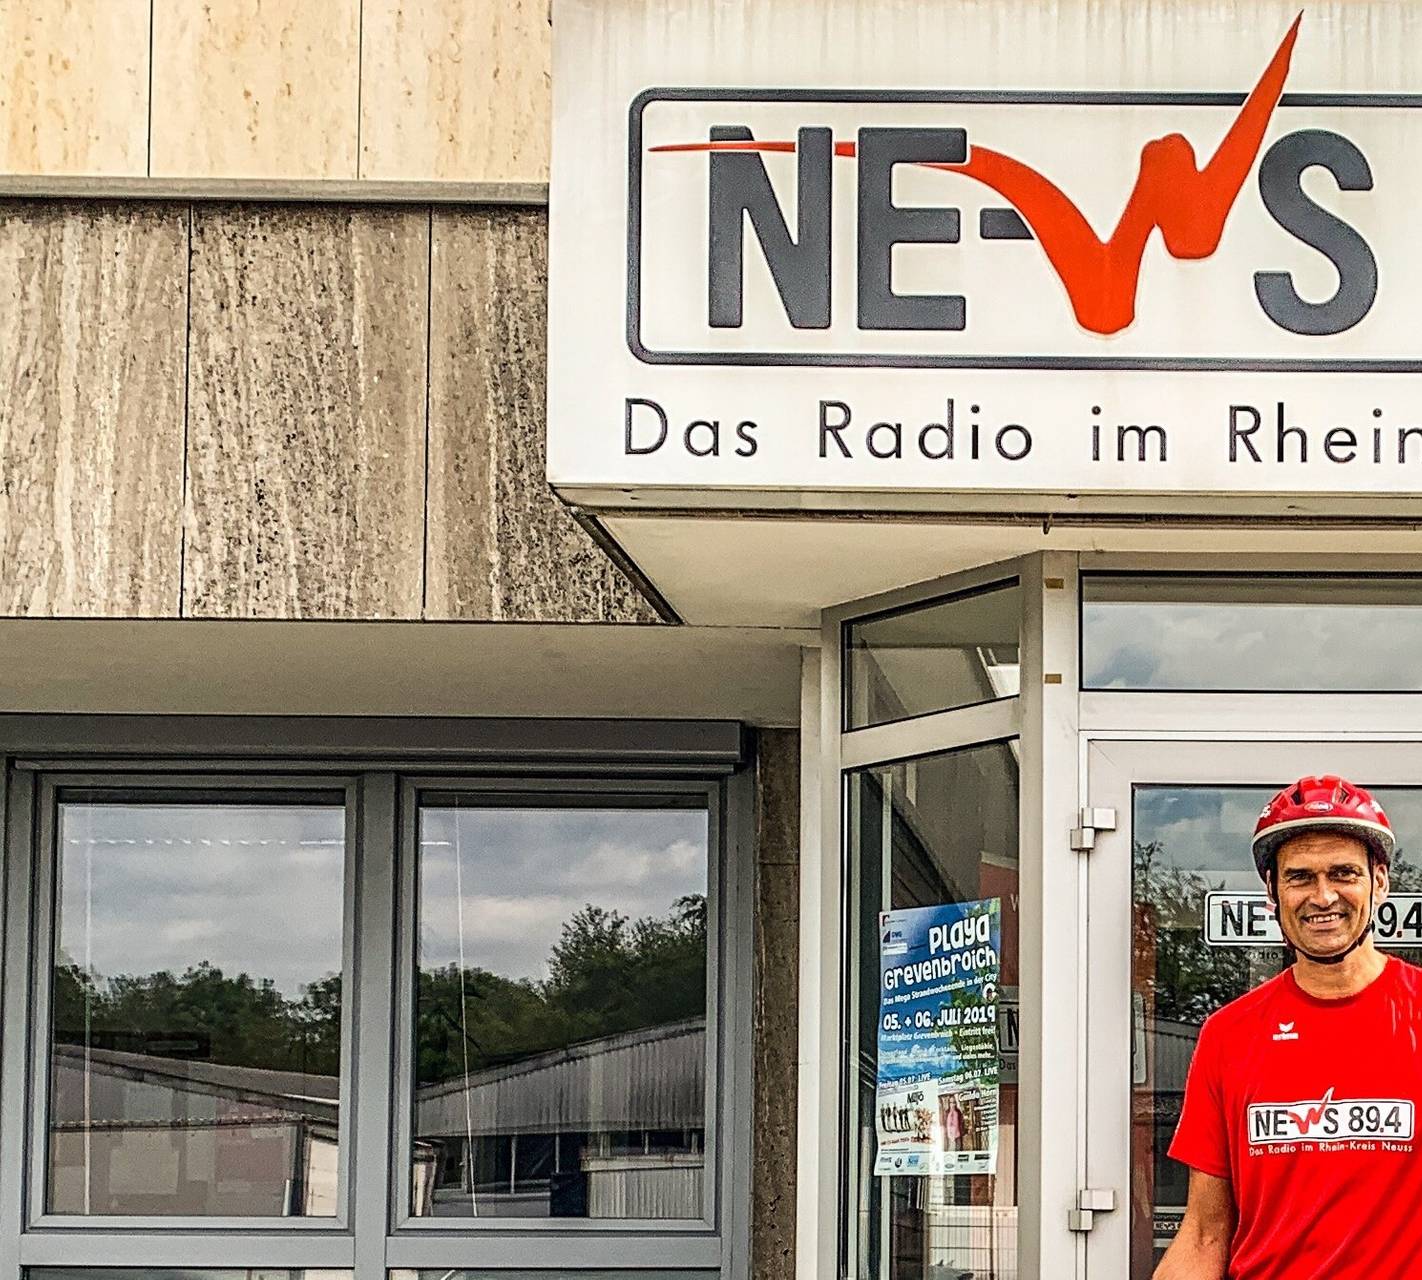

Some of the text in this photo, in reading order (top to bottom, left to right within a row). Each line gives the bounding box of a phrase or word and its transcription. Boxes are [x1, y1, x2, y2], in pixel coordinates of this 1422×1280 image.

[623, 397, 759, 458] Das
[818, 398, 1034, 461] Radio
[1091, 405, 1168, 462] im
[884, 945, 996, 990] Grevenbroich
[883, 1004, 996, 1031] 05. + 06. JULI 2019
[984, 1066, 998, 1076] LIVE
[1347, 1105, 1402, 1134] 89.4
[1249, 1140, 1413, 1157] Das Radio im Rhein-Kreis Neuss
